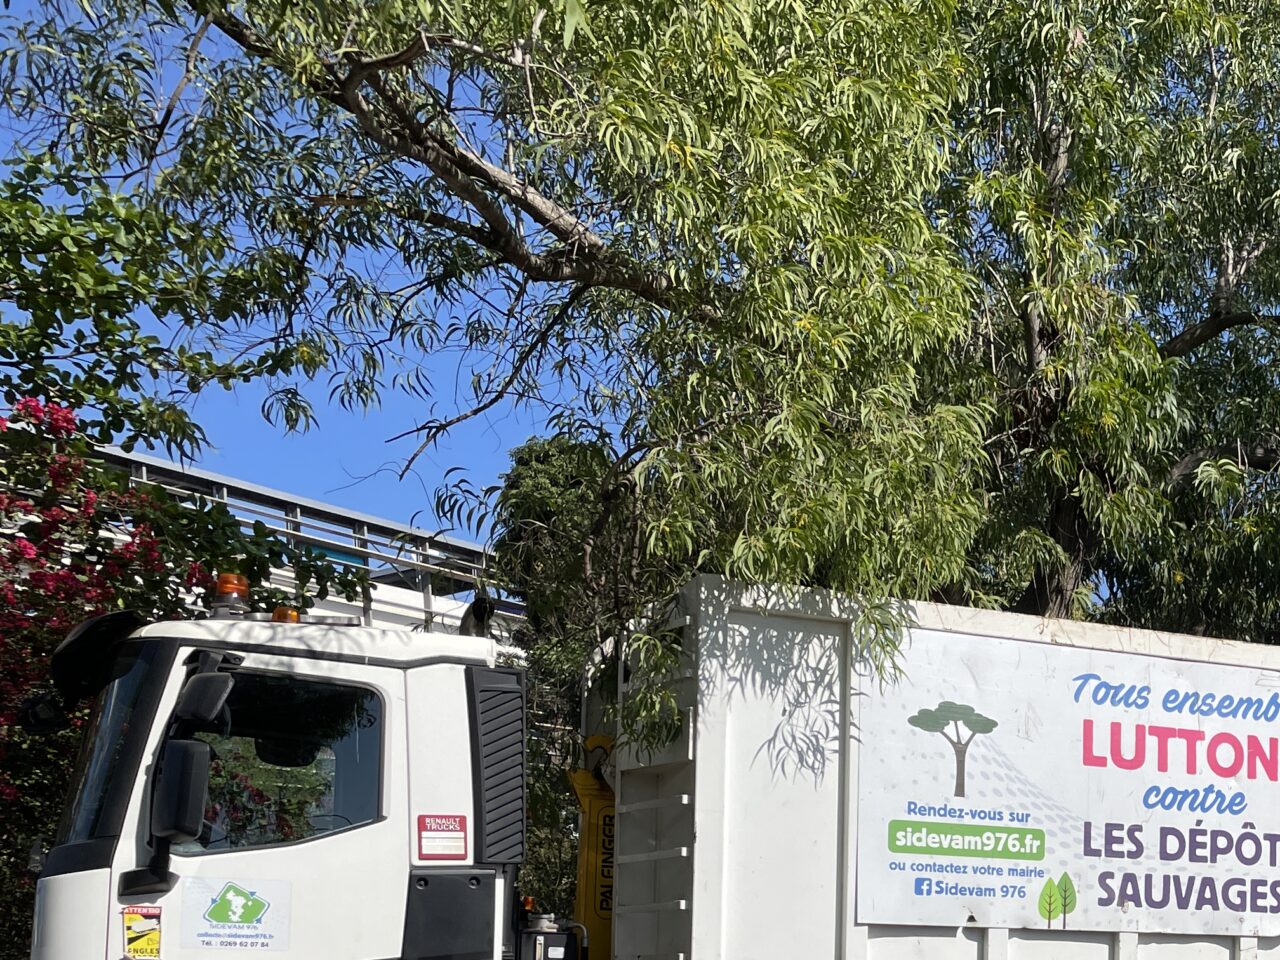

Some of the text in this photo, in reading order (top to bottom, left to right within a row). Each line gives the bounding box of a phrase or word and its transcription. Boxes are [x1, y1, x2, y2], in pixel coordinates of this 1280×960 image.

[1072, 673, 1151, 709] Tous
[907, 801, 1031, 823] Rendez-vous sur
[1142, 784, 1248, 816] contre
[895, 827, 1041, 854] sidevam976.fr
[1083, 821, 1144, 860] LES
[889, 861, 1045, 878] ou contactez votre mairie
[934, 880, 996, 897] Sidevam
[1000, 885, 1026, 898] 976
